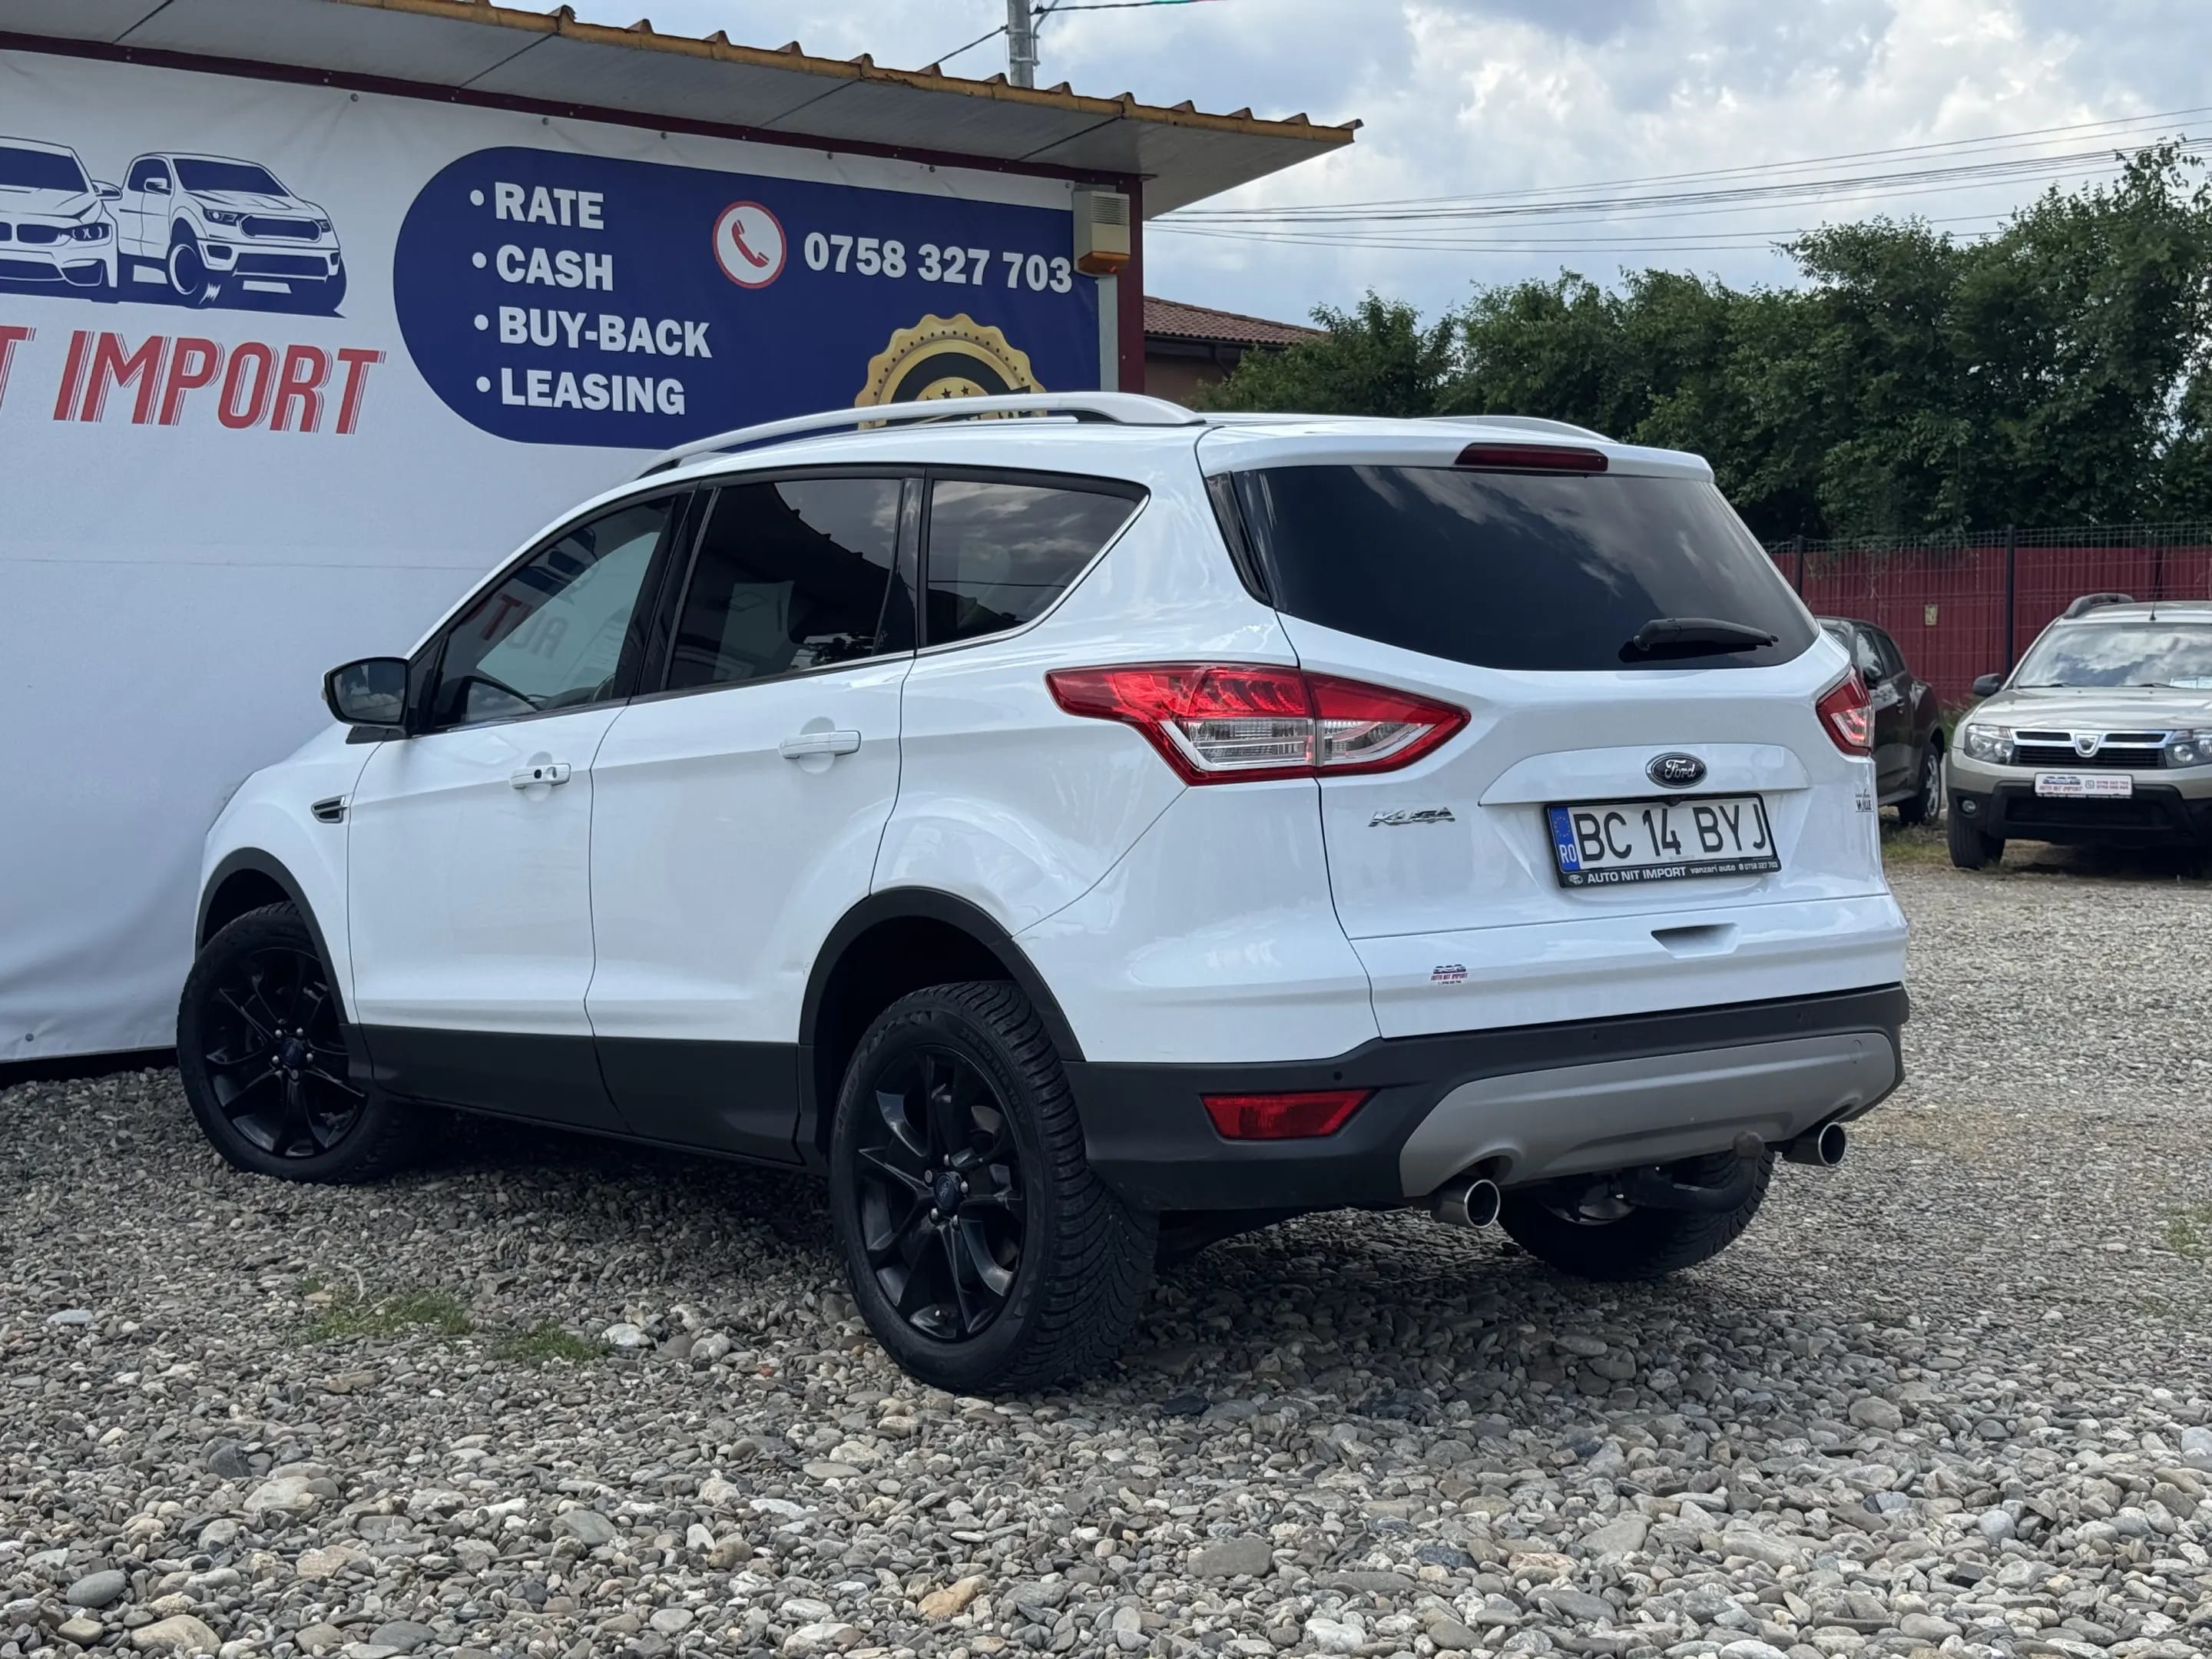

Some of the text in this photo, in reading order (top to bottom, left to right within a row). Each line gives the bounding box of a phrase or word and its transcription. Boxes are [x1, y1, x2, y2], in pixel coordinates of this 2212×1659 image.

[495, 182, 604, 230] RATE
[497, 244, 613, 290] CASH
[804, 232, 1072, 293] 0758 327 703
[499, 306, 712, 358] BUY-BACK
[53, 330, 386, 435] IMPORT
[501, 368, 685, 415] LEASING
[1664, 760, 1696, 778] Ford
[1560, 844, 1578, 863] RO
[1574, 804, 1767, 861] BC 14 BYJ
[1588, 871, 1619, 883] AUTO
[1621, 869, 1639, 881] NIT
[1642, 866, 1687, 879] IMPORT
